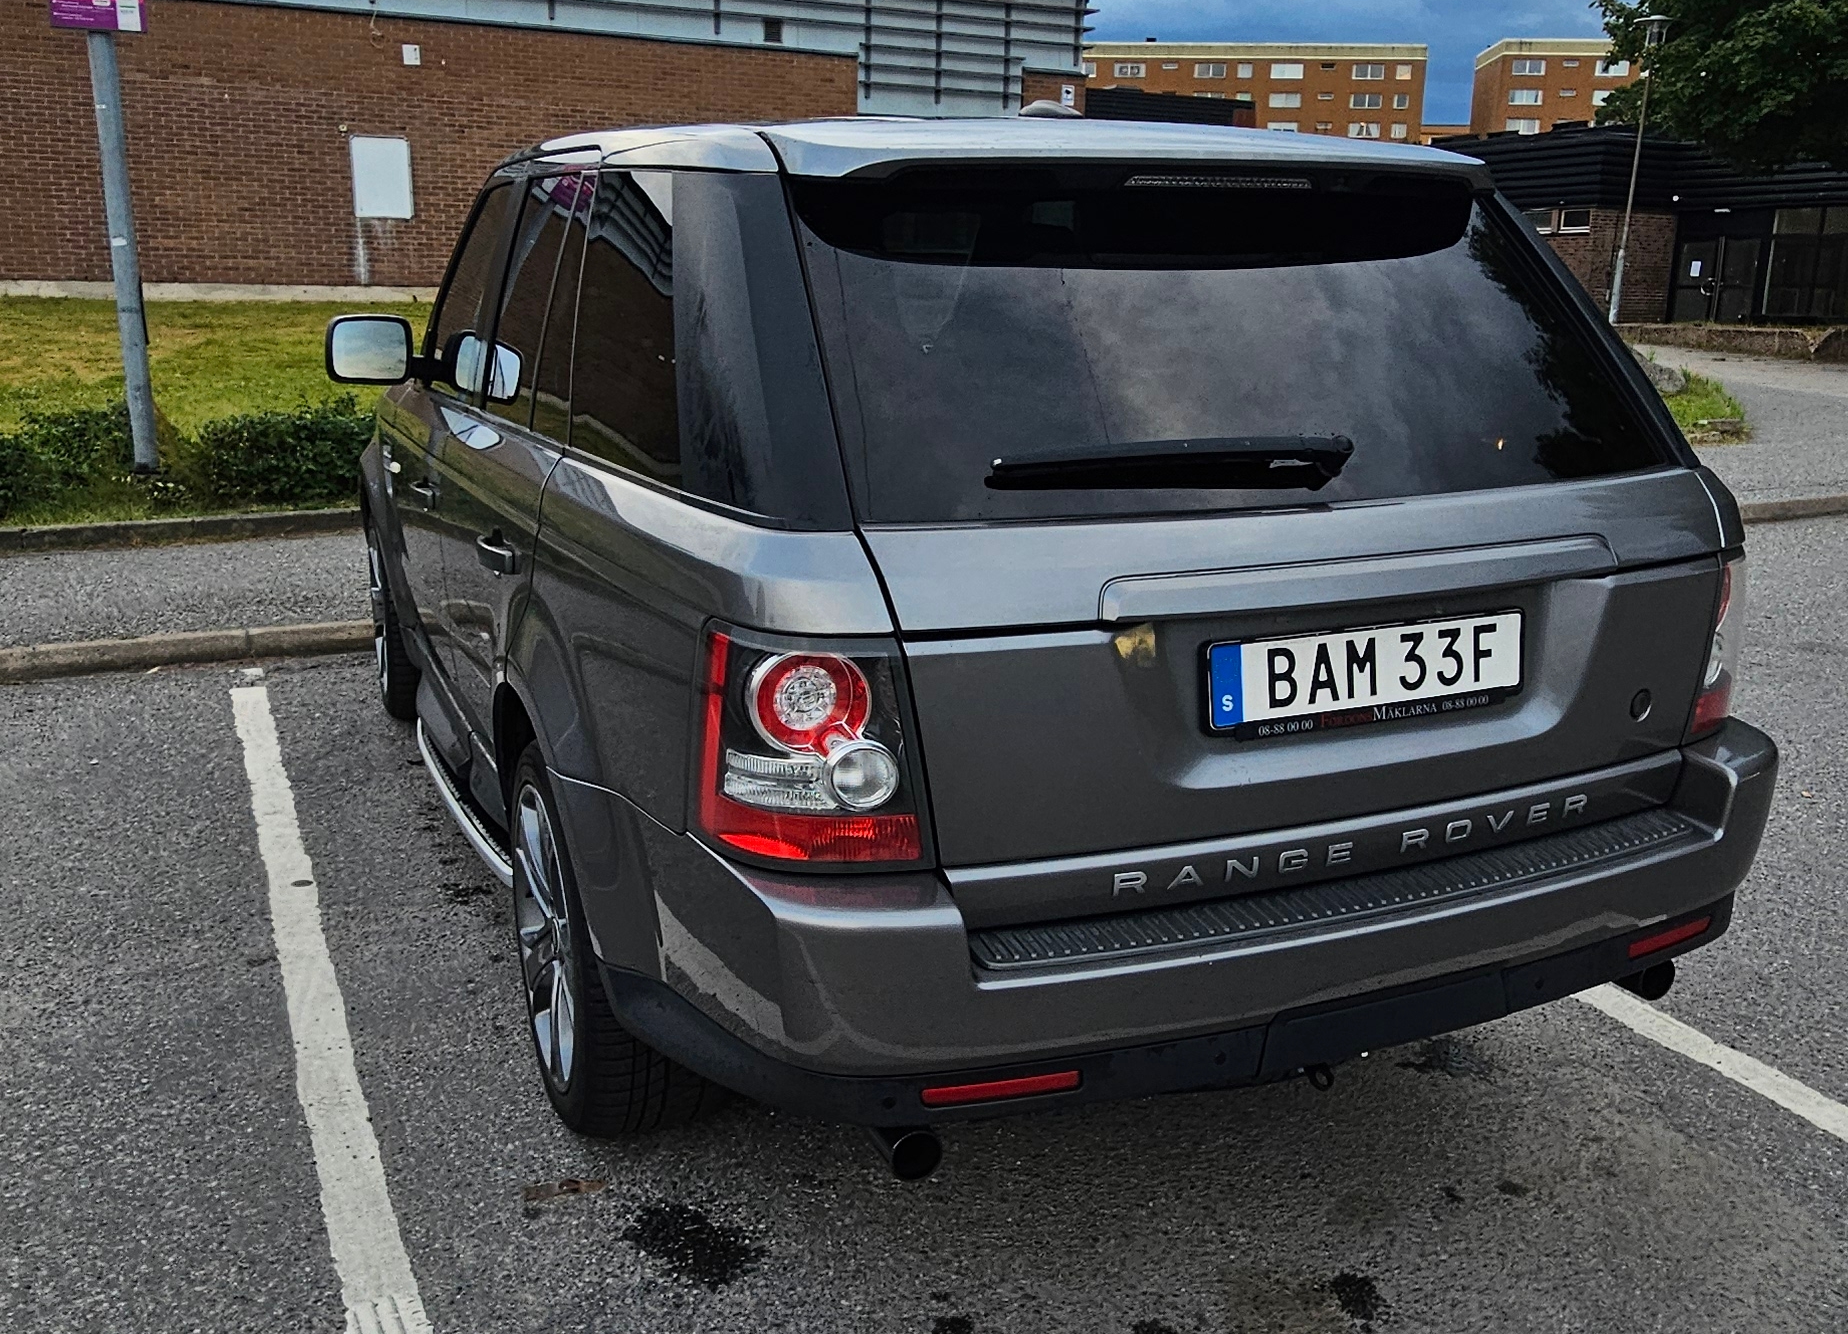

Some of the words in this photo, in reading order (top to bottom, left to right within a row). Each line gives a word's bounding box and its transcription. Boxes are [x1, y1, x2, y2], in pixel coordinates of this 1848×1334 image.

[1221, 694, 1234, 712] S
[1266, 637, 1378, 710] BAM
[1398, 623, 1498, 691] 33F
[1258, 724, 1285, 737] 08-88
[1287, 721, 1300, 733] 00
[1301, 719, 1314, 731] 00
[1442, 699, 1465, 711] 08-88
[1466, 696, 1478, 709] 00
[1478, 694, 1489, 705] 00
[1112, 842, 1354, 898] RANGE
[1400, 794, 1589, 854] ROVER
